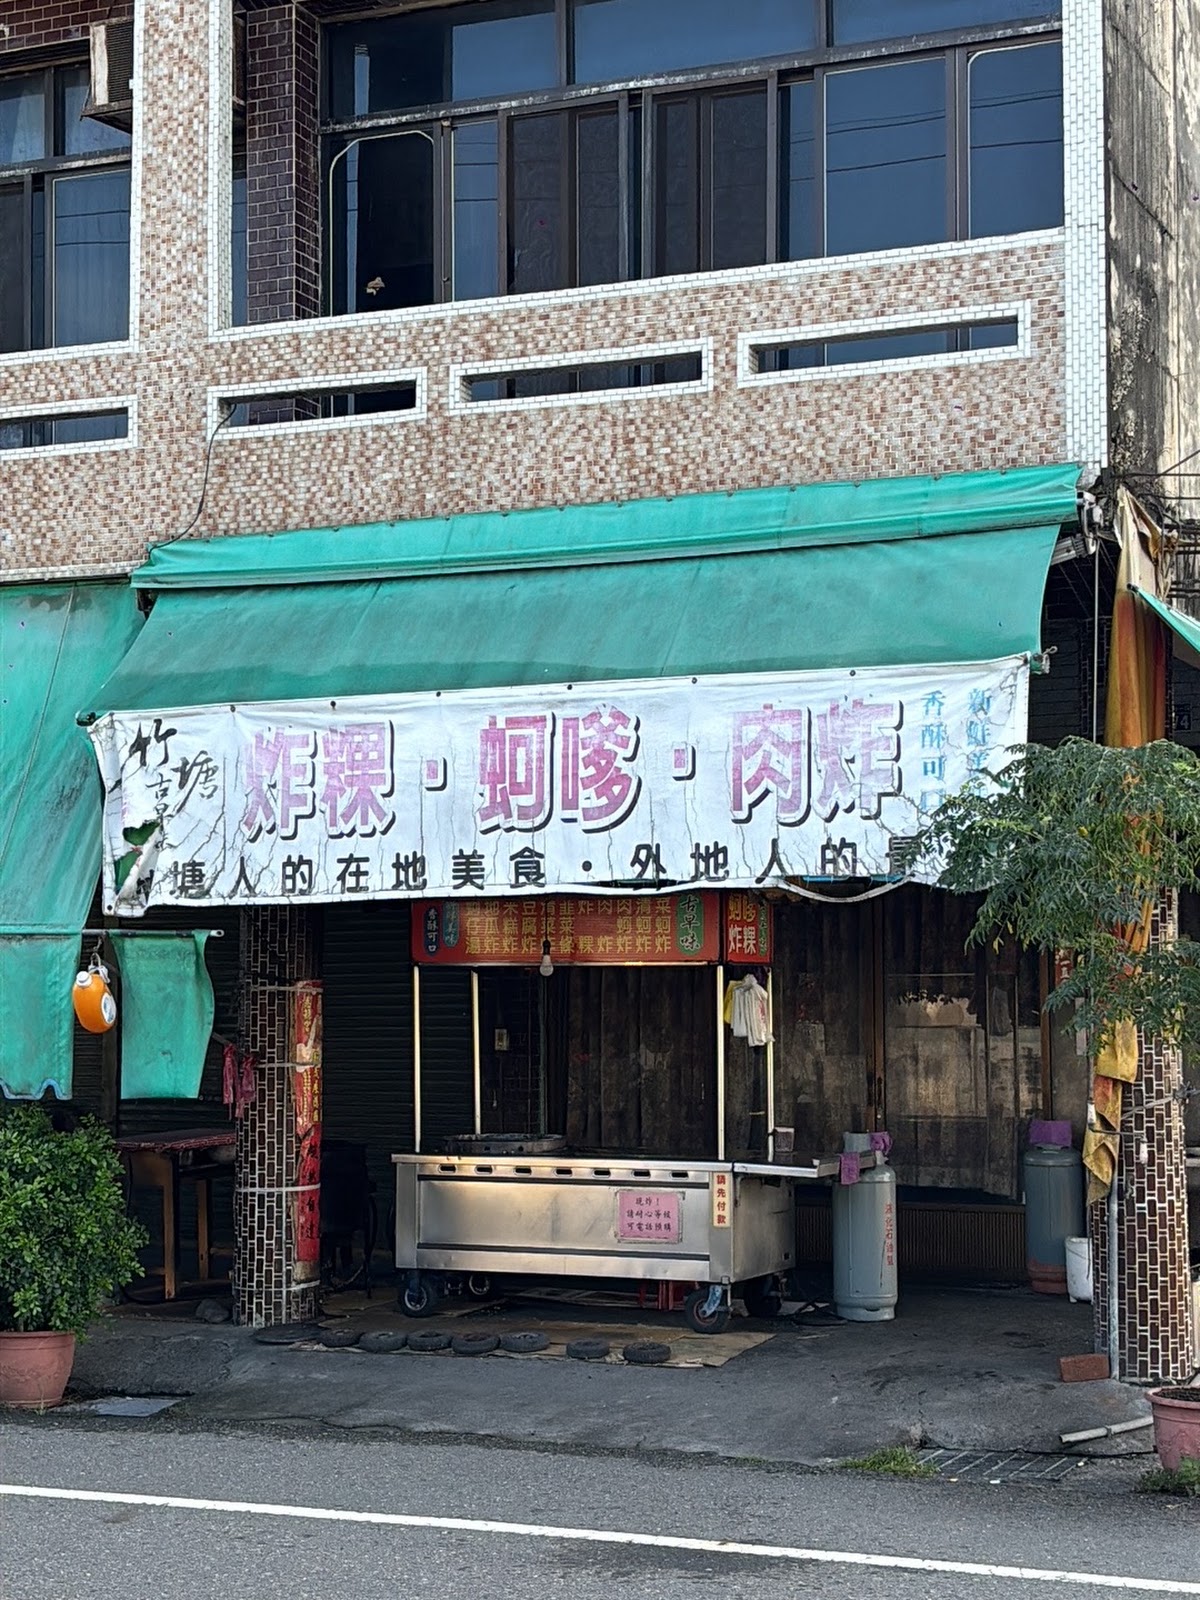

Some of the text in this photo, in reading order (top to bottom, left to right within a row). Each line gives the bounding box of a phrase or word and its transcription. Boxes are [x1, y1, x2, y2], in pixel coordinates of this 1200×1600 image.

[680, 894, 701, 951] 古早味
[728, 924, 757, 954] 炸粿
[716, 1174, 727, 1225] 請先付款
